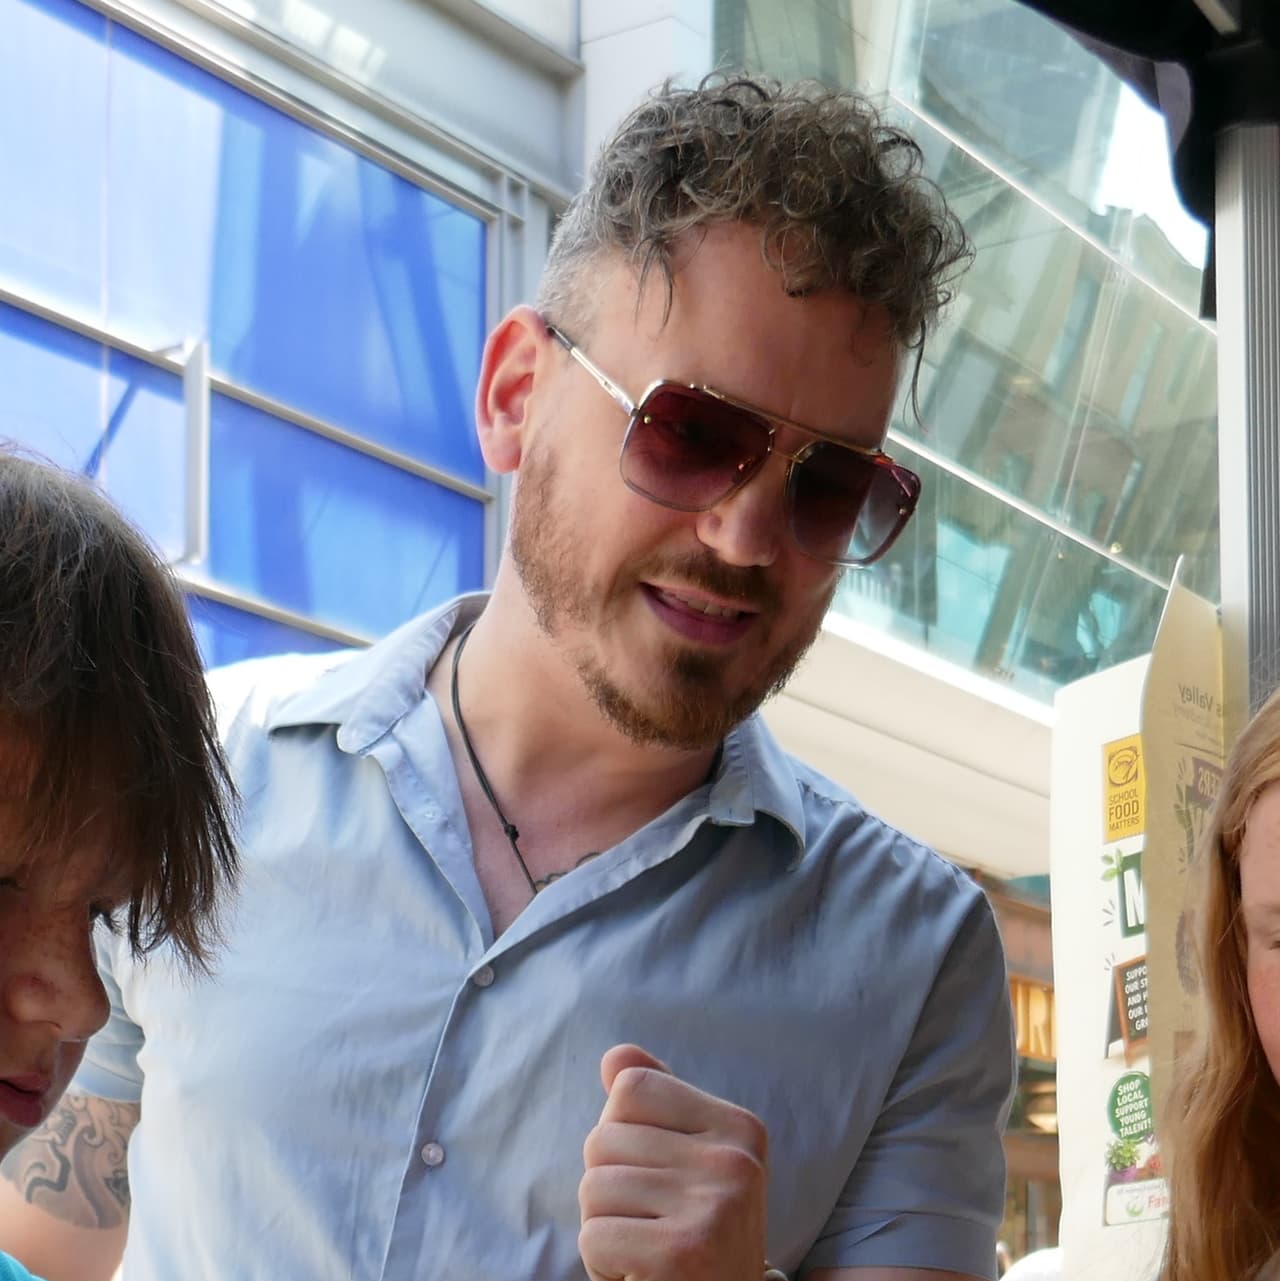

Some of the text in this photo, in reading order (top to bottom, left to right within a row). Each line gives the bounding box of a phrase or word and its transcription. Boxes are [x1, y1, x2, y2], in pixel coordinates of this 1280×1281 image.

[1108, 788, 1139, 806] SCHOOL
[1108, 799, 1140, 822] FOOD
[1108, 815, 1140, 831] MATTERS
[1125, 981, 1140, 994] OUR
[1128, 993, 1142, 1007] AND
[1128, 1005, 1144, 1020] OUR
[1117, 1079, 1141, 1096] SHOP
[1116, 1089, 1145, 1107] LOCAL
[1115, 1097, 1149, 1118] SUPPORT
[1120, 1109, 1147, 1127] YOUNG
